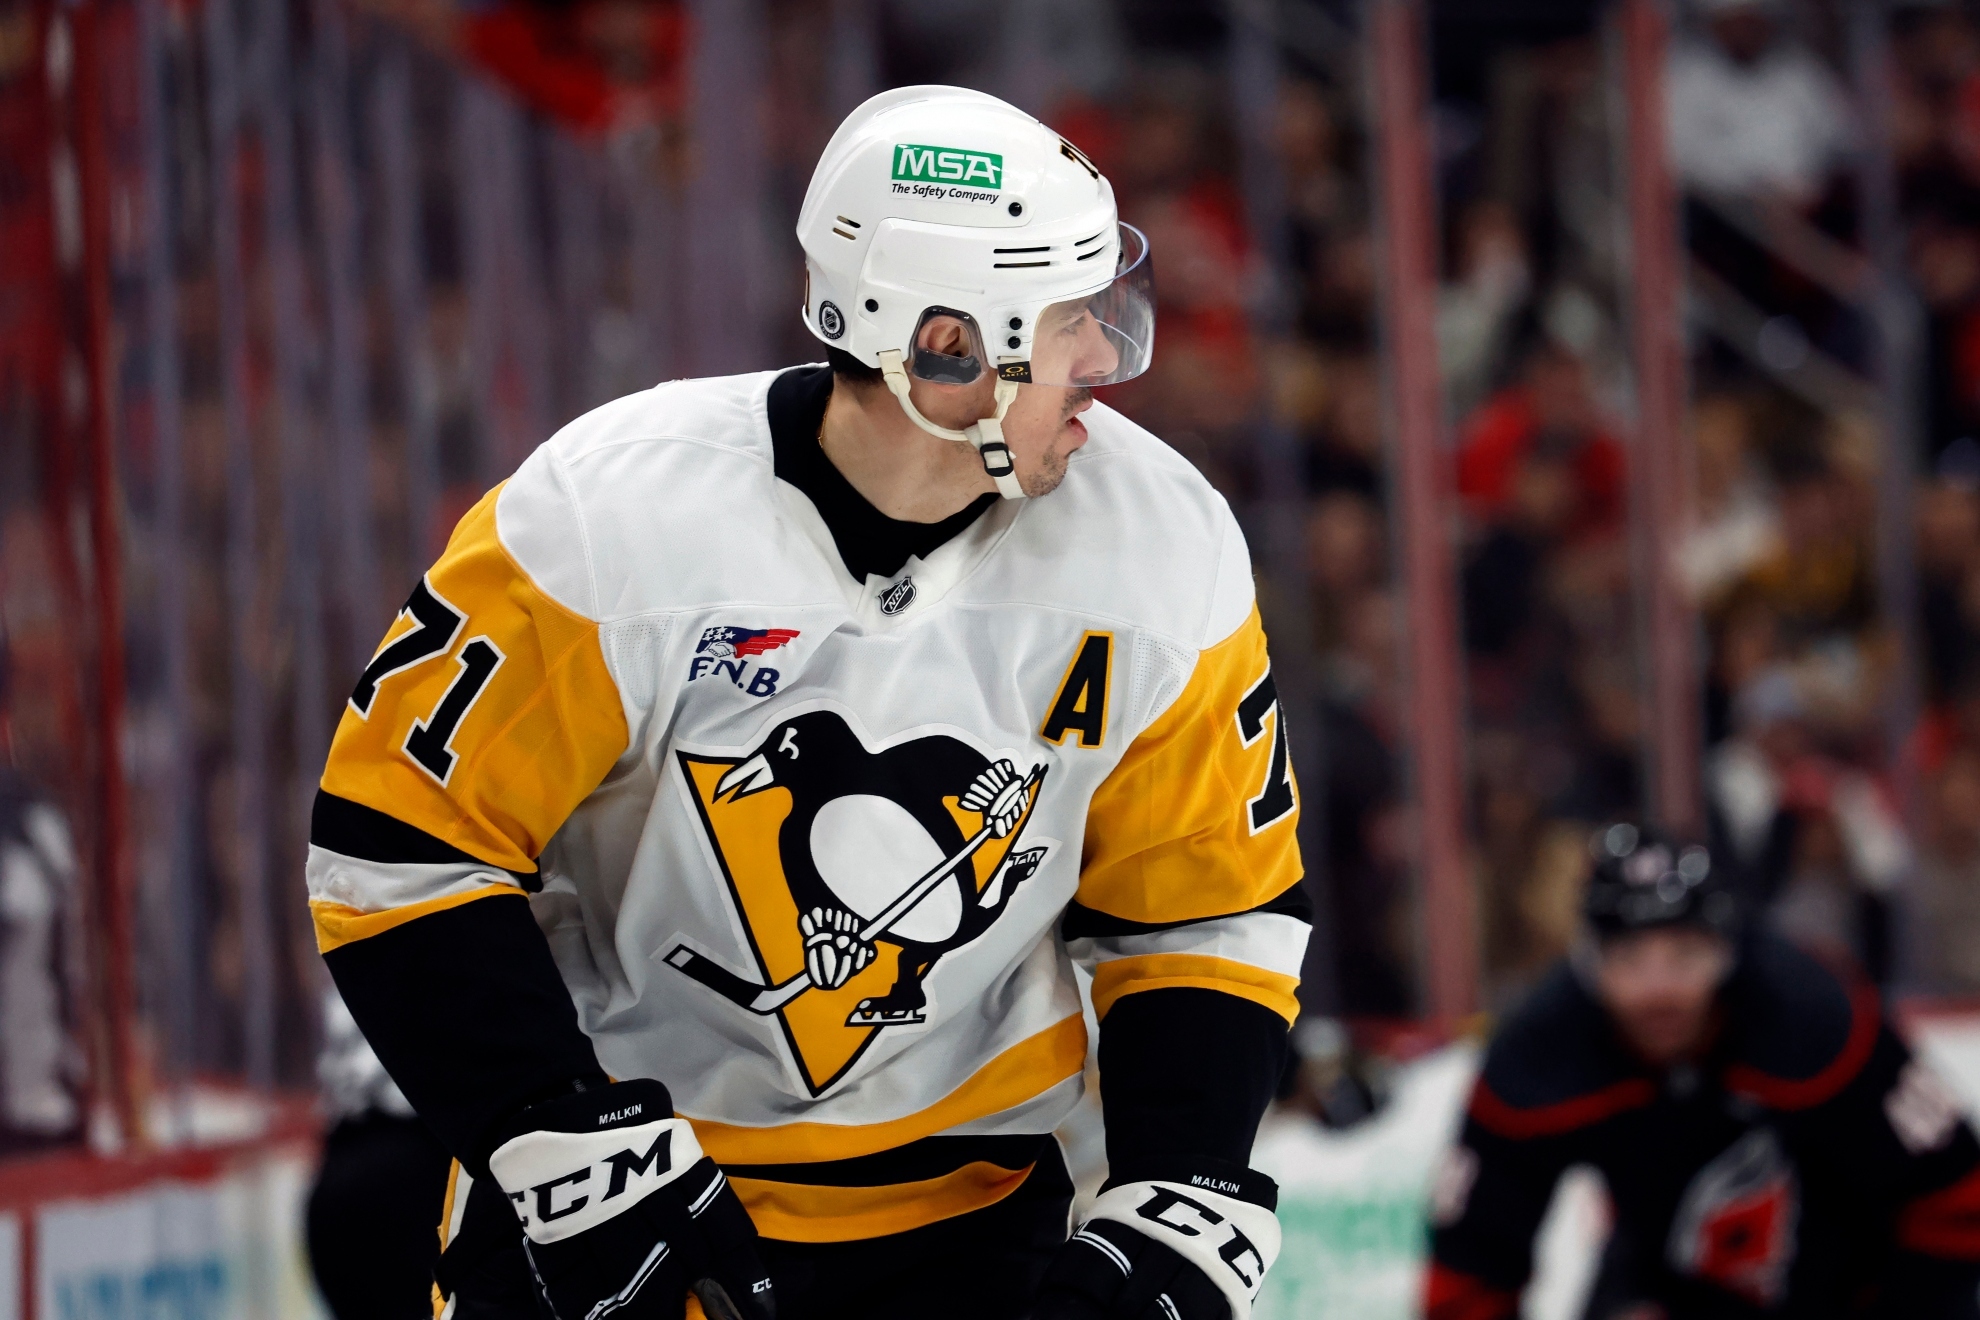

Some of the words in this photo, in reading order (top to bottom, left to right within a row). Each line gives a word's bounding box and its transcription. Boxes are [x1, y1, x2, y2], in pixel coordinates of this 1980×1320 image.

[897, 148, 996, 184] MSA
[892, 183, 910, 194] The
[912, 185, 946, 199] Safety
[949, 188, 999, 205] Company
[888, 584, 908, 611] NHL
[348, 569, 507, 789] 71
[1039, 629, 1114, 749] A
[598, 1103, 642, 1126] MALKIN
[1190, 1174, 1240, 1194] MALKIN
